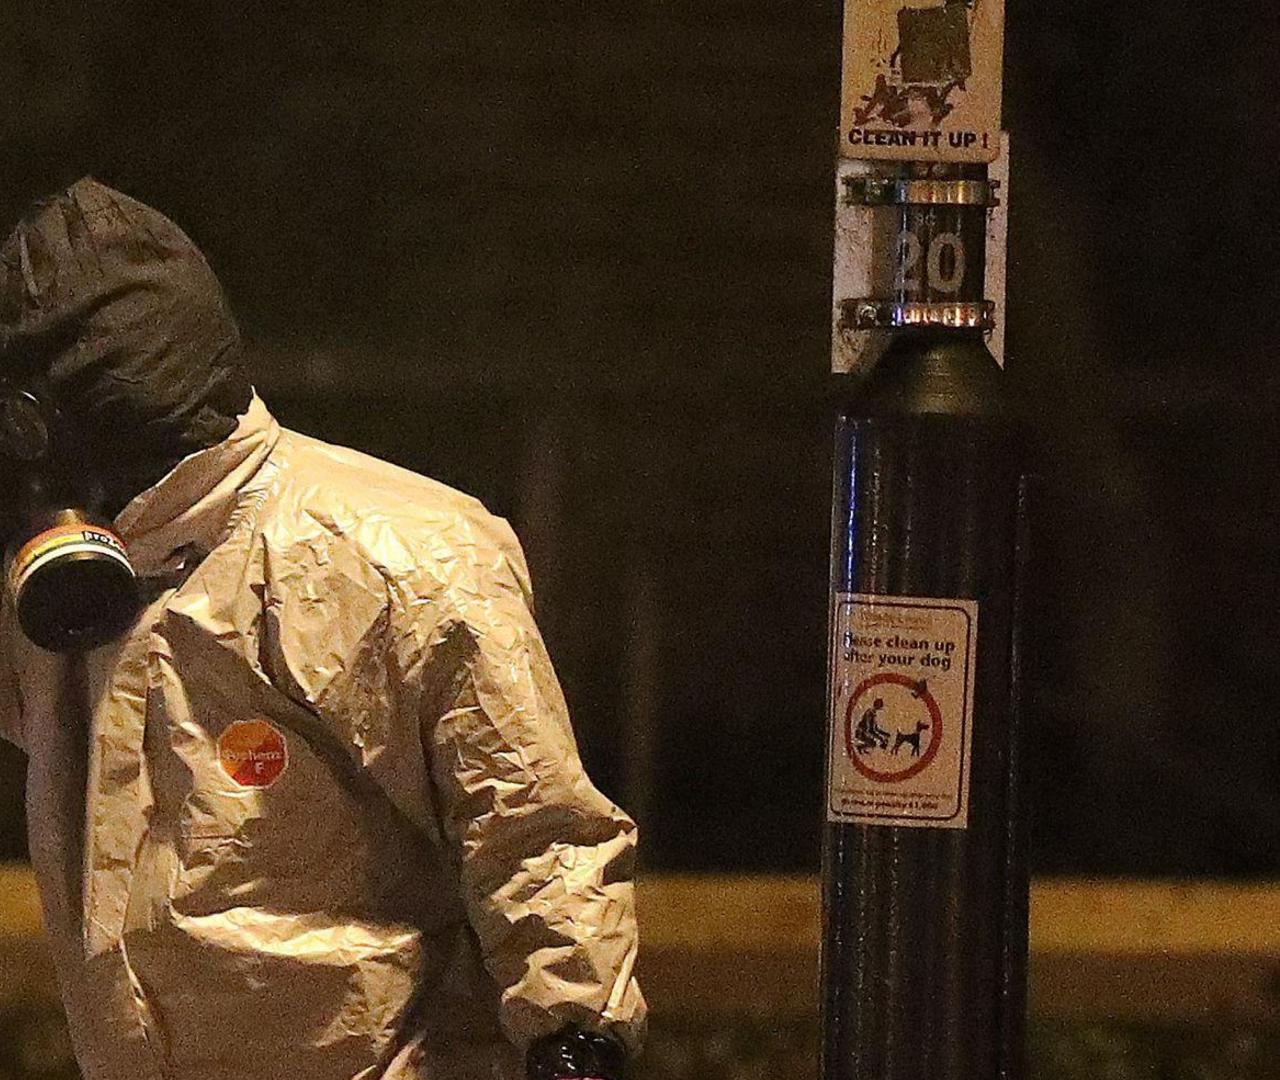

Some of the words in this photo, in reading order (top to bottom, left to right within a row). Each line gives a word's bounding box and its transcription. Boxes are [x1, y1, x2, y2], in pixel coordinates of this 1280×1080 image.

[848, 129, 916, 147] CLEAN
[922, 130, 942, 147] IT
[949, 132, 977, 148] UP
[896, 232, 966, 293] 20
[886, 636, 929, 650] clean
[934, 639, 956, 655] up
[878, 652, 915, 667] your
[920, 652, 952, 671] dog
